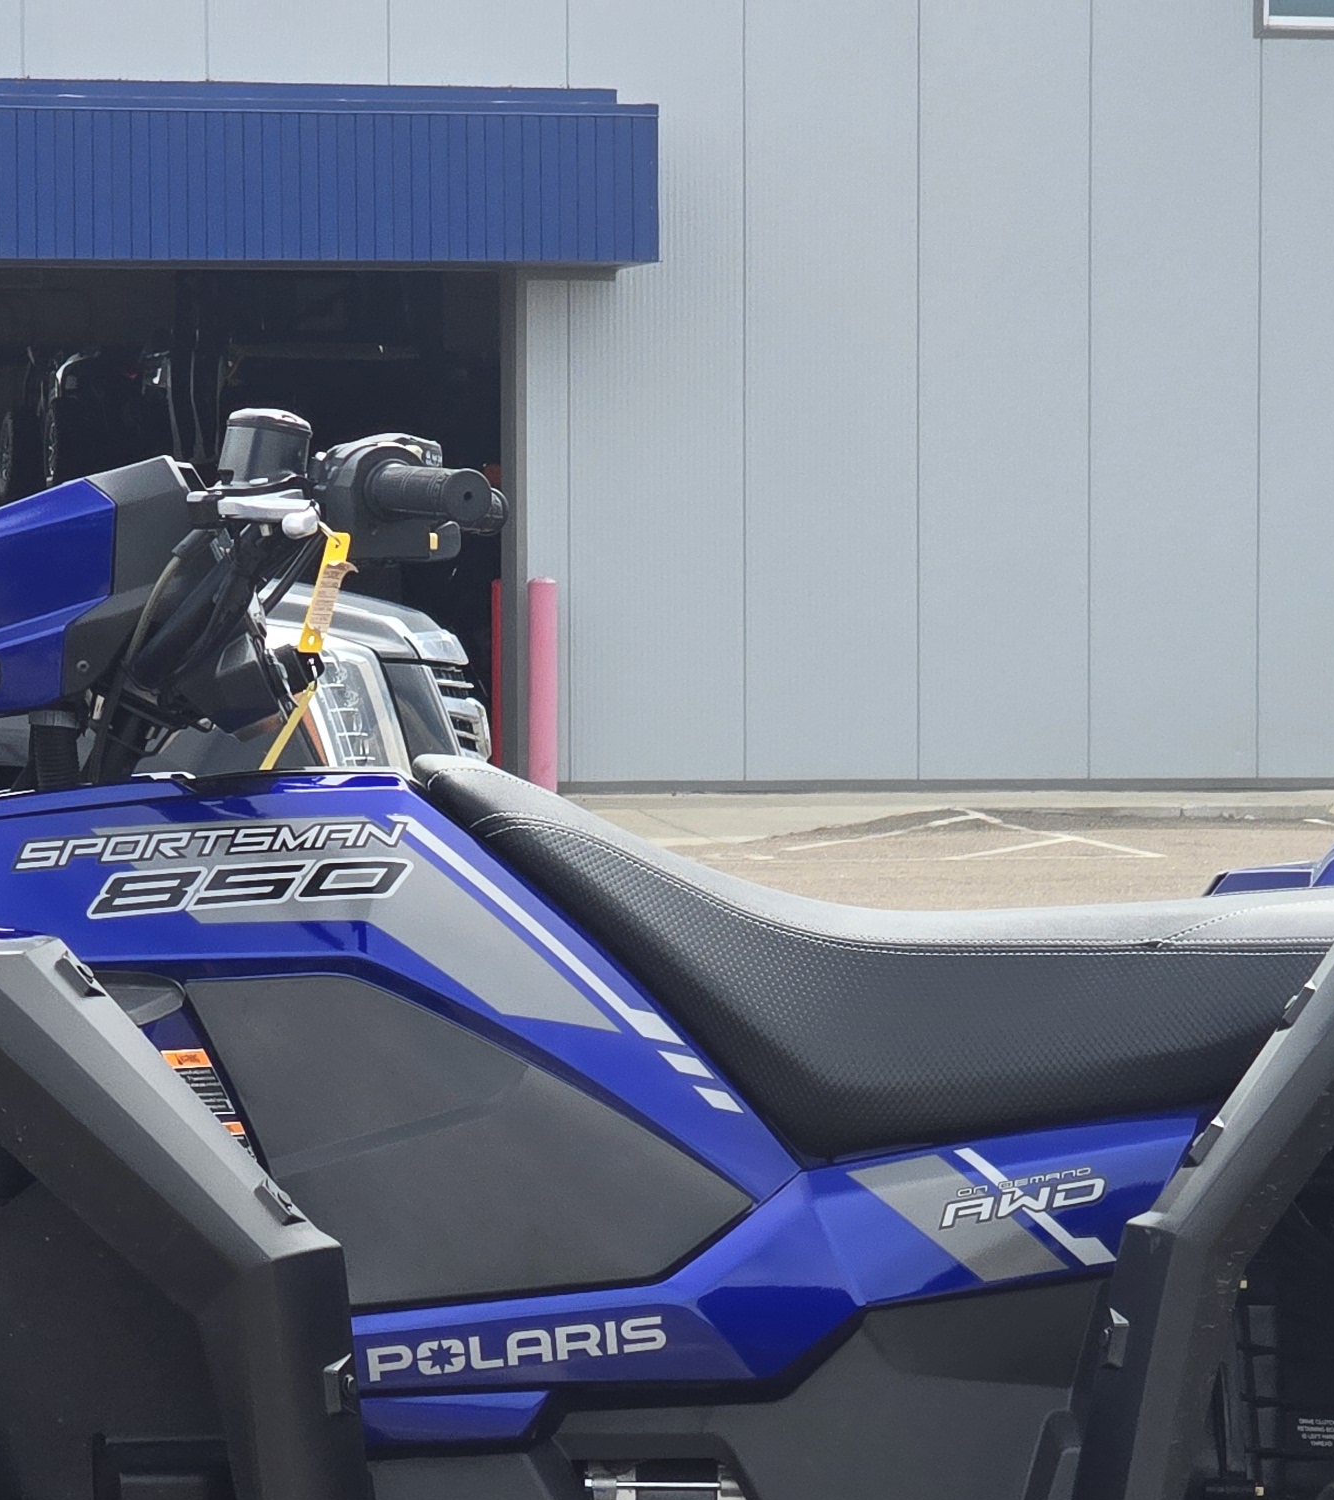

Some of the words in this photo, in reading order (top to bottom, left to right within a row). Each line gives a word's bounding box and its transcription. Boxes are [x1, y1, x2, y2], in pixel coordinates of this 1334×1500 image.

[15, 821, 408, 870] SPORTSMAN
[87, 857, 414, 919] 850
[940, 1178, 1105, 1229] AWD
[957, 1185, 988, 1197] ON
[998, 1167, 1091, 1189] DEMAND
[366, 1316, 667, 1383] POLARIS
